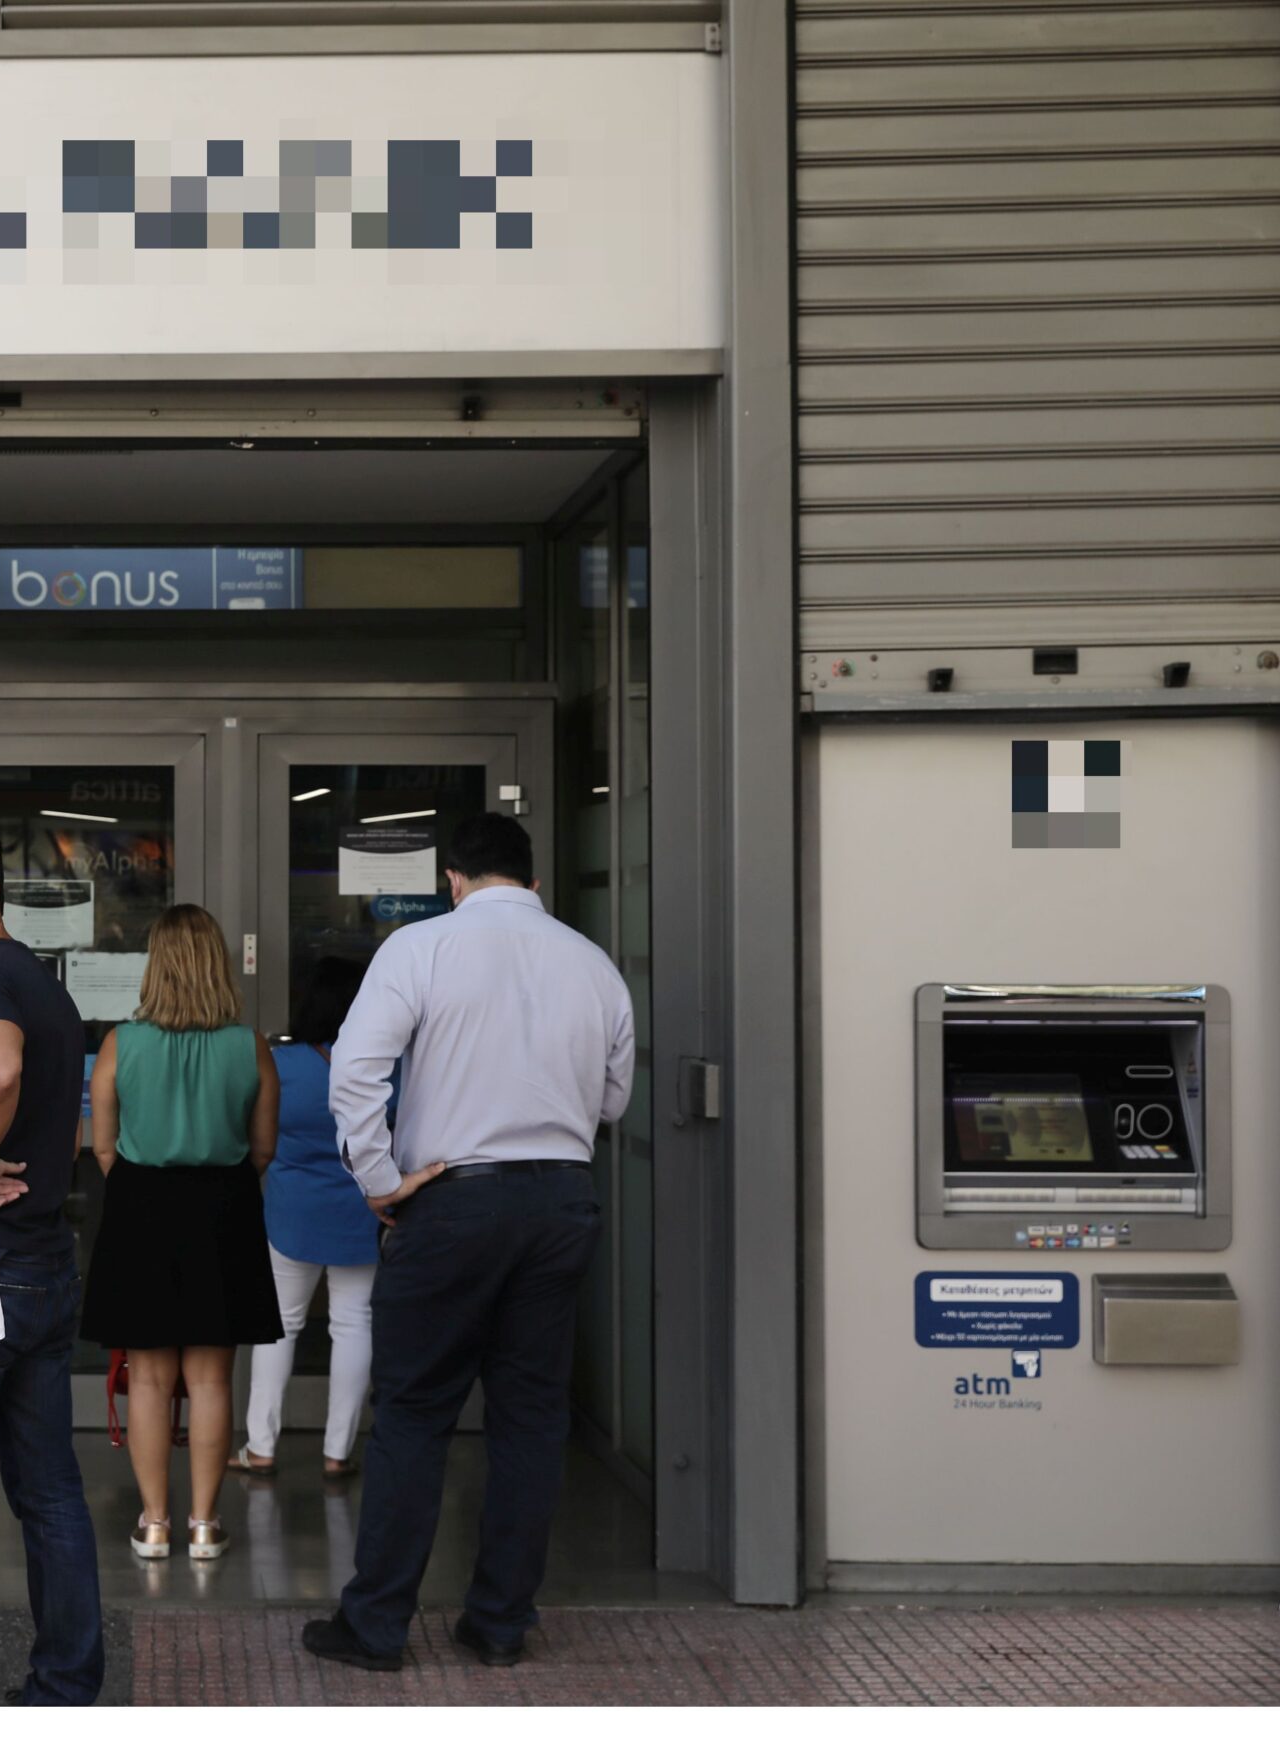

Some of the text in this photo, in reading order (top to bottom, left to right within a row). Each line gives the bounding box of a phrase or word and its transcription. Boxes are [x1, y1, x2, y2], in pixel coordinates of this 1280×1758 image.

[11, 559, 180, 607] bonus
[954, 1373, 1011, 1396] atm
[953, 1397, 1042, 1411] 24 Hour Banking
